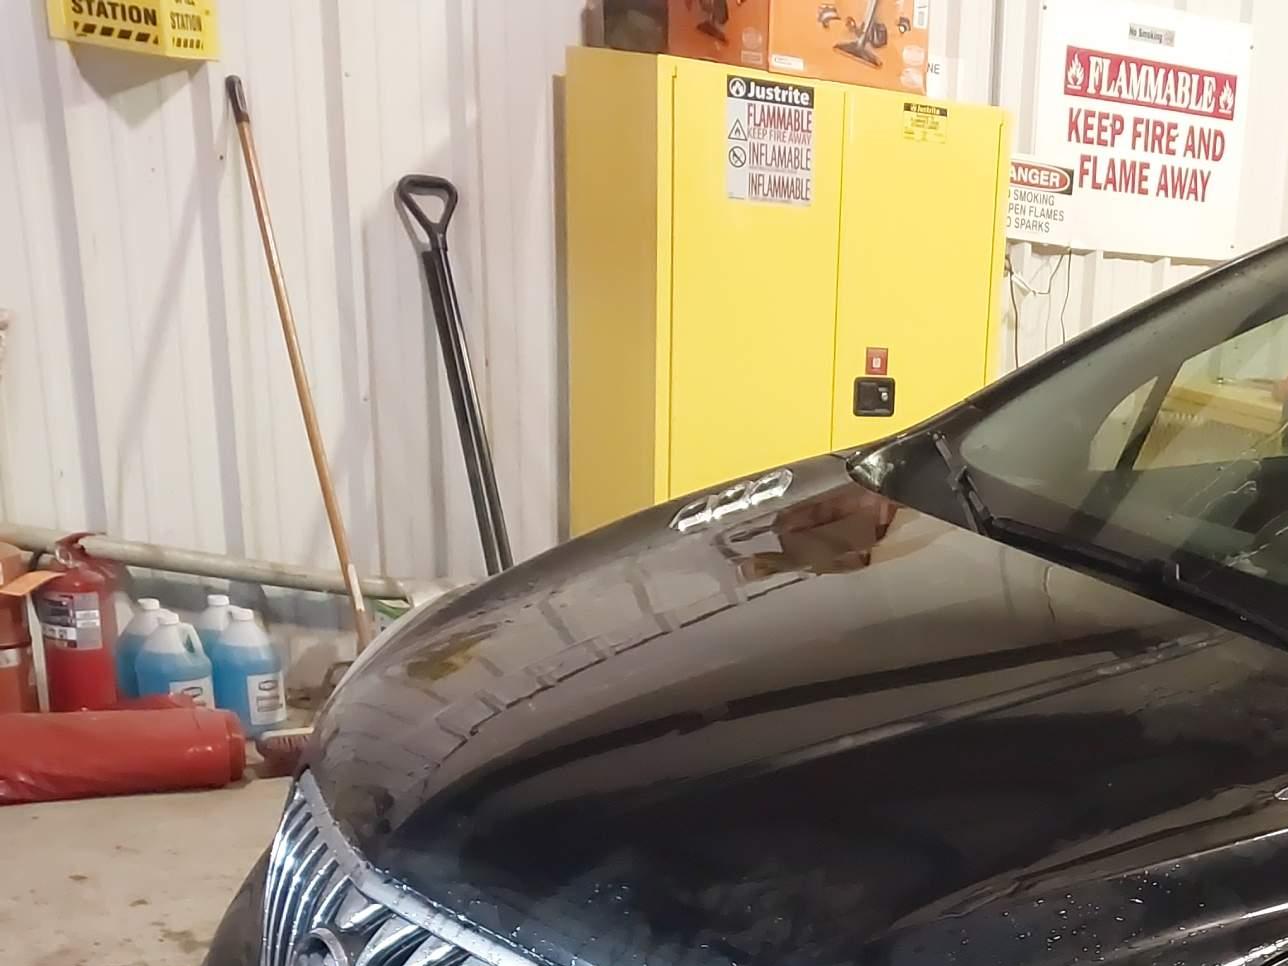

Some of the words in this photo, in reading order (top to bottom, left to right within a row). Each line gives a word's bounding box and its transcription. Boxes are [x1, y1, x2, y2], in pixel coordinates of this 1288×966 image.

[72, 0, 158, 27] STATION
[170, 12, 203, 32] STATION
[1129, 25, 1138, 37] No
[1138, 28, 1163, 44] Smoking
[926, 62, 941, 75] NE
[747, 81, 811, 106] Justrite
[1086, 55, 1217, 113] FLAMMABLE
[747, 102, 813, 133] FLAMMABLE
[747, 126, 768, 140] KEEP
[769, 129, 786, 143] FIRE
[787, 132, 813, 145] AWAY
[1067, 107, 1125, 148] KEEP
[1131, 116, 1179, 156] FIRE
[1183, 125, 1226, 162] AND
[748, 141, 811, 171] INFLAMABLE
[748, 172, 811, 201] INFLAMMABLE
[1010, 165, 1060, 188] ANGER
[1078, 153, 1151, 195] FLAME
[1155, 164, 1212, 203] AWAY
[1013, 189, 1055, 206] SMOKING
[1008, 202, 1026, 216] PEN
[1028, 205, 1065, 222] FLAMES
[1014, 217, 1051, 233] SPARKS
